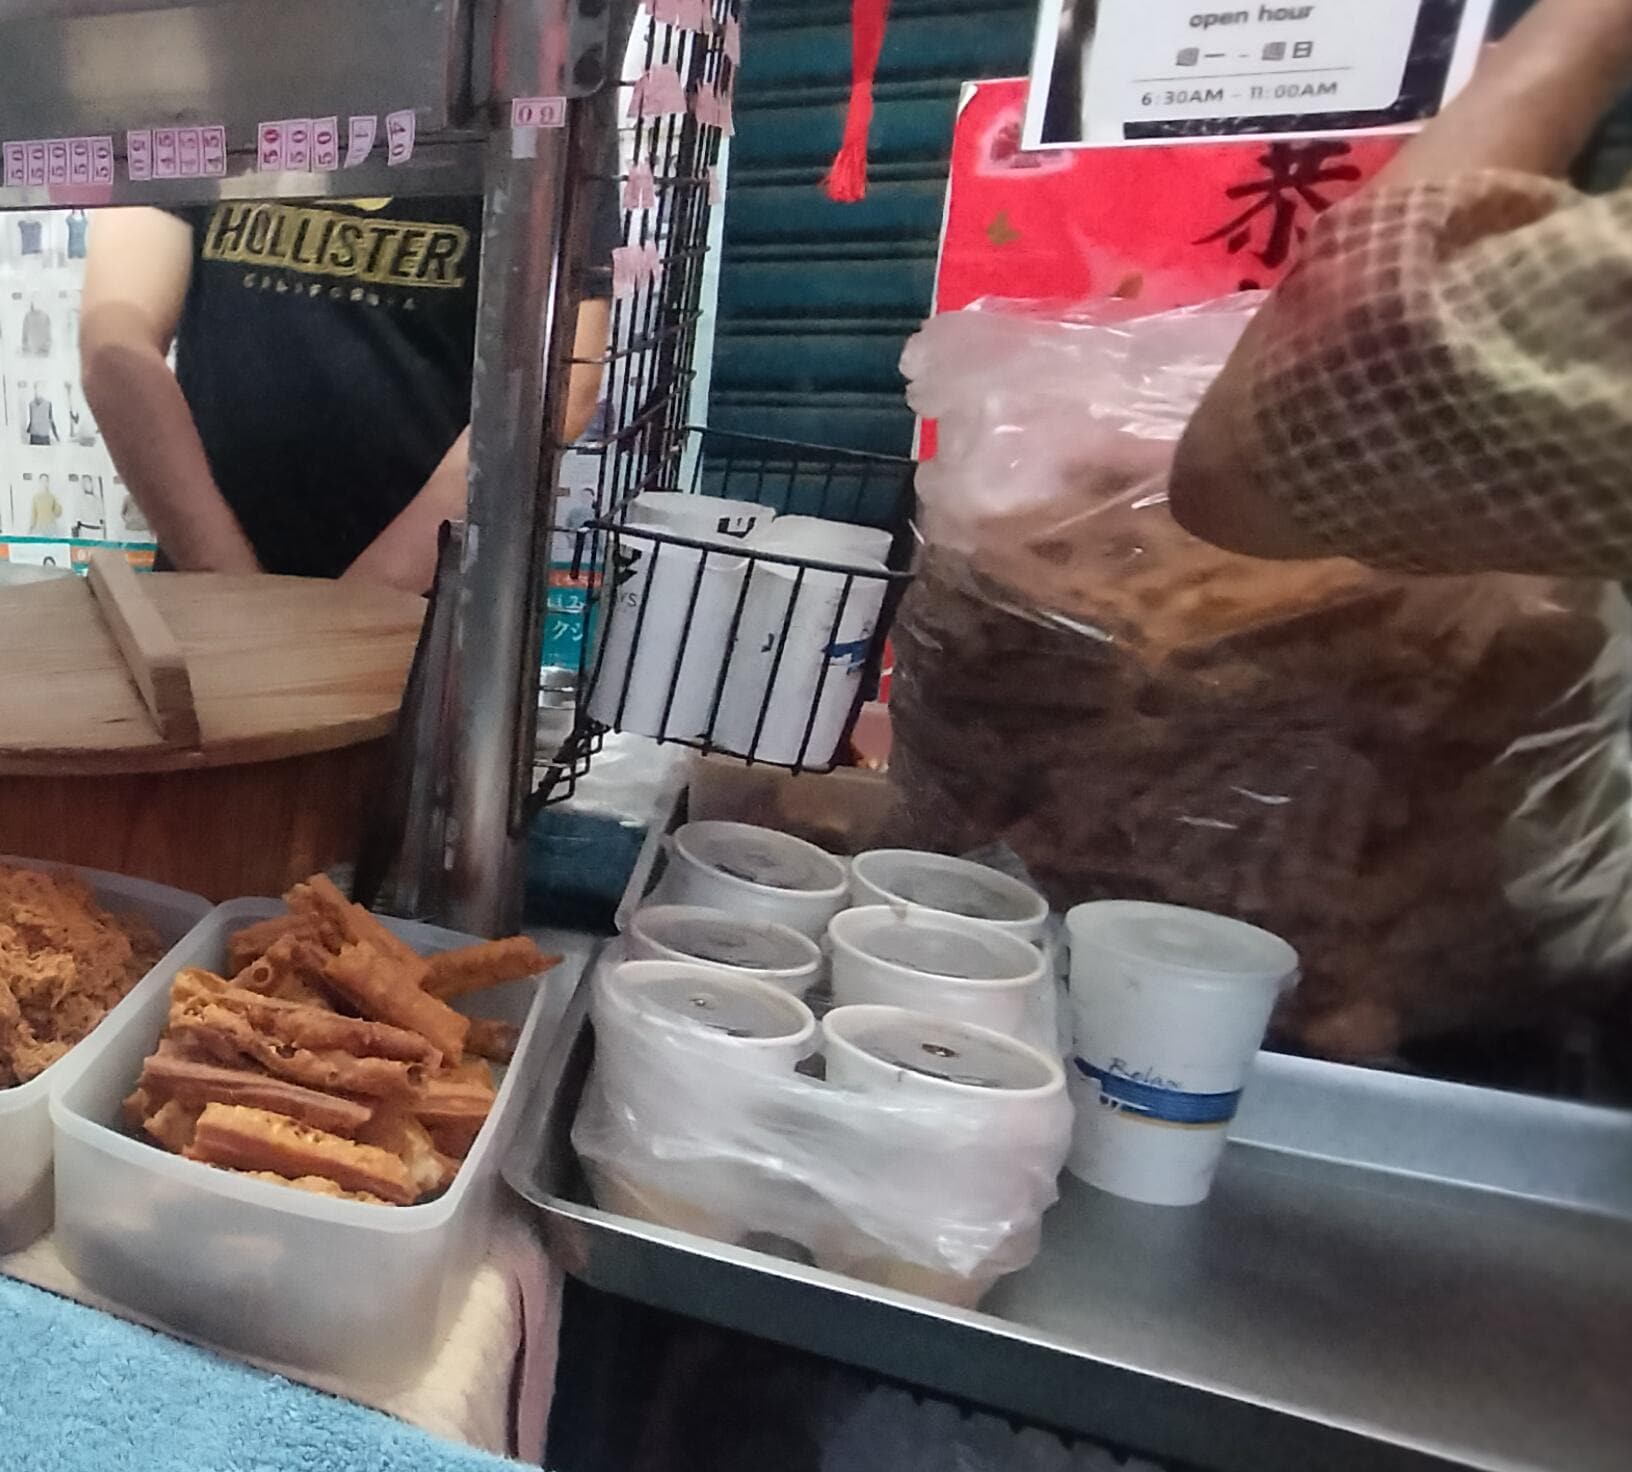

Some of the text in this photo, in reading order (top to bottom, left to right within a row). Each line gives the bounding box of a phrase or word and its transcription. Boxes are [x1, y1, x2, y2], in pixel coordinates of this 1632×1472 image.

[1189, 4, 1316, 31] open hour
[263, 127, 280, 164] 50
[289, 129, 307, 163] 50
[317, 131, 333, 165] 50
[1191, 142, 1361, 269] 恭
[211, 205, 464, 282] HOLLISTER
